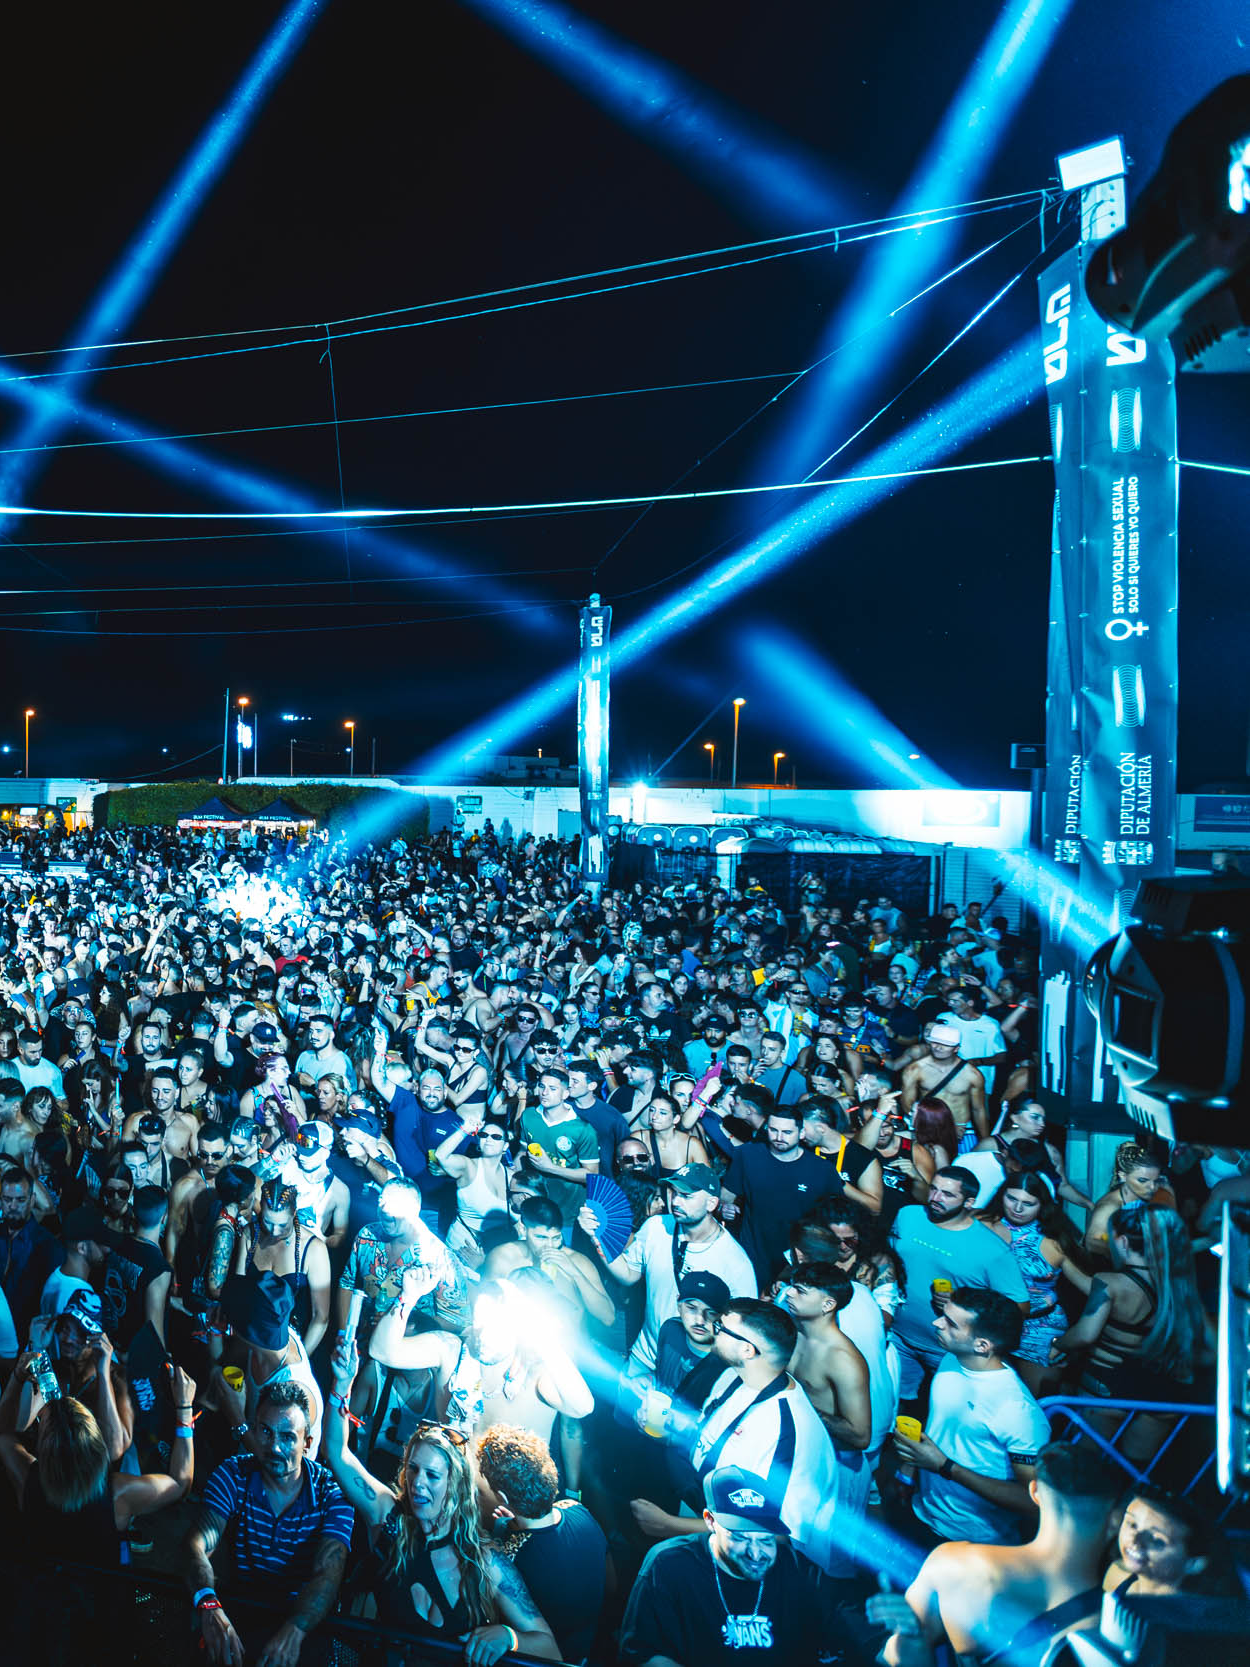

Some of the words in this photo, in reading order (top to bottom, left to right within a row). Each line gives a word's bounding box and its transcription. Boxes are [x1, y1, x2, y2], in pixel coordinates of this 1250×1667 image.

[1112, 477, 1125, 521] SEXUAL
[1128, 476, 1140, 515] QUIERO
[1128, 516, 1139, 530] YO
[1112, 522, 1125, 583] VIOLENCIA
[1128, 531, 1141, 574] QUIERES
[1112, 584, 1125, 614] STOP
[1128, 575, 1139, 585] SI
[1128, 586, 1139, 614] SOLO
[1065, 754, 1081, 834] DIPUTACIÓN
[1117, 752, 1136, 835] DIPUTACIÓN
[1135, 755, 1152, 815] ALMERÍA
[1136, 817, 1150, 835] DE
[734, 1622, 773, 1648] VANS
